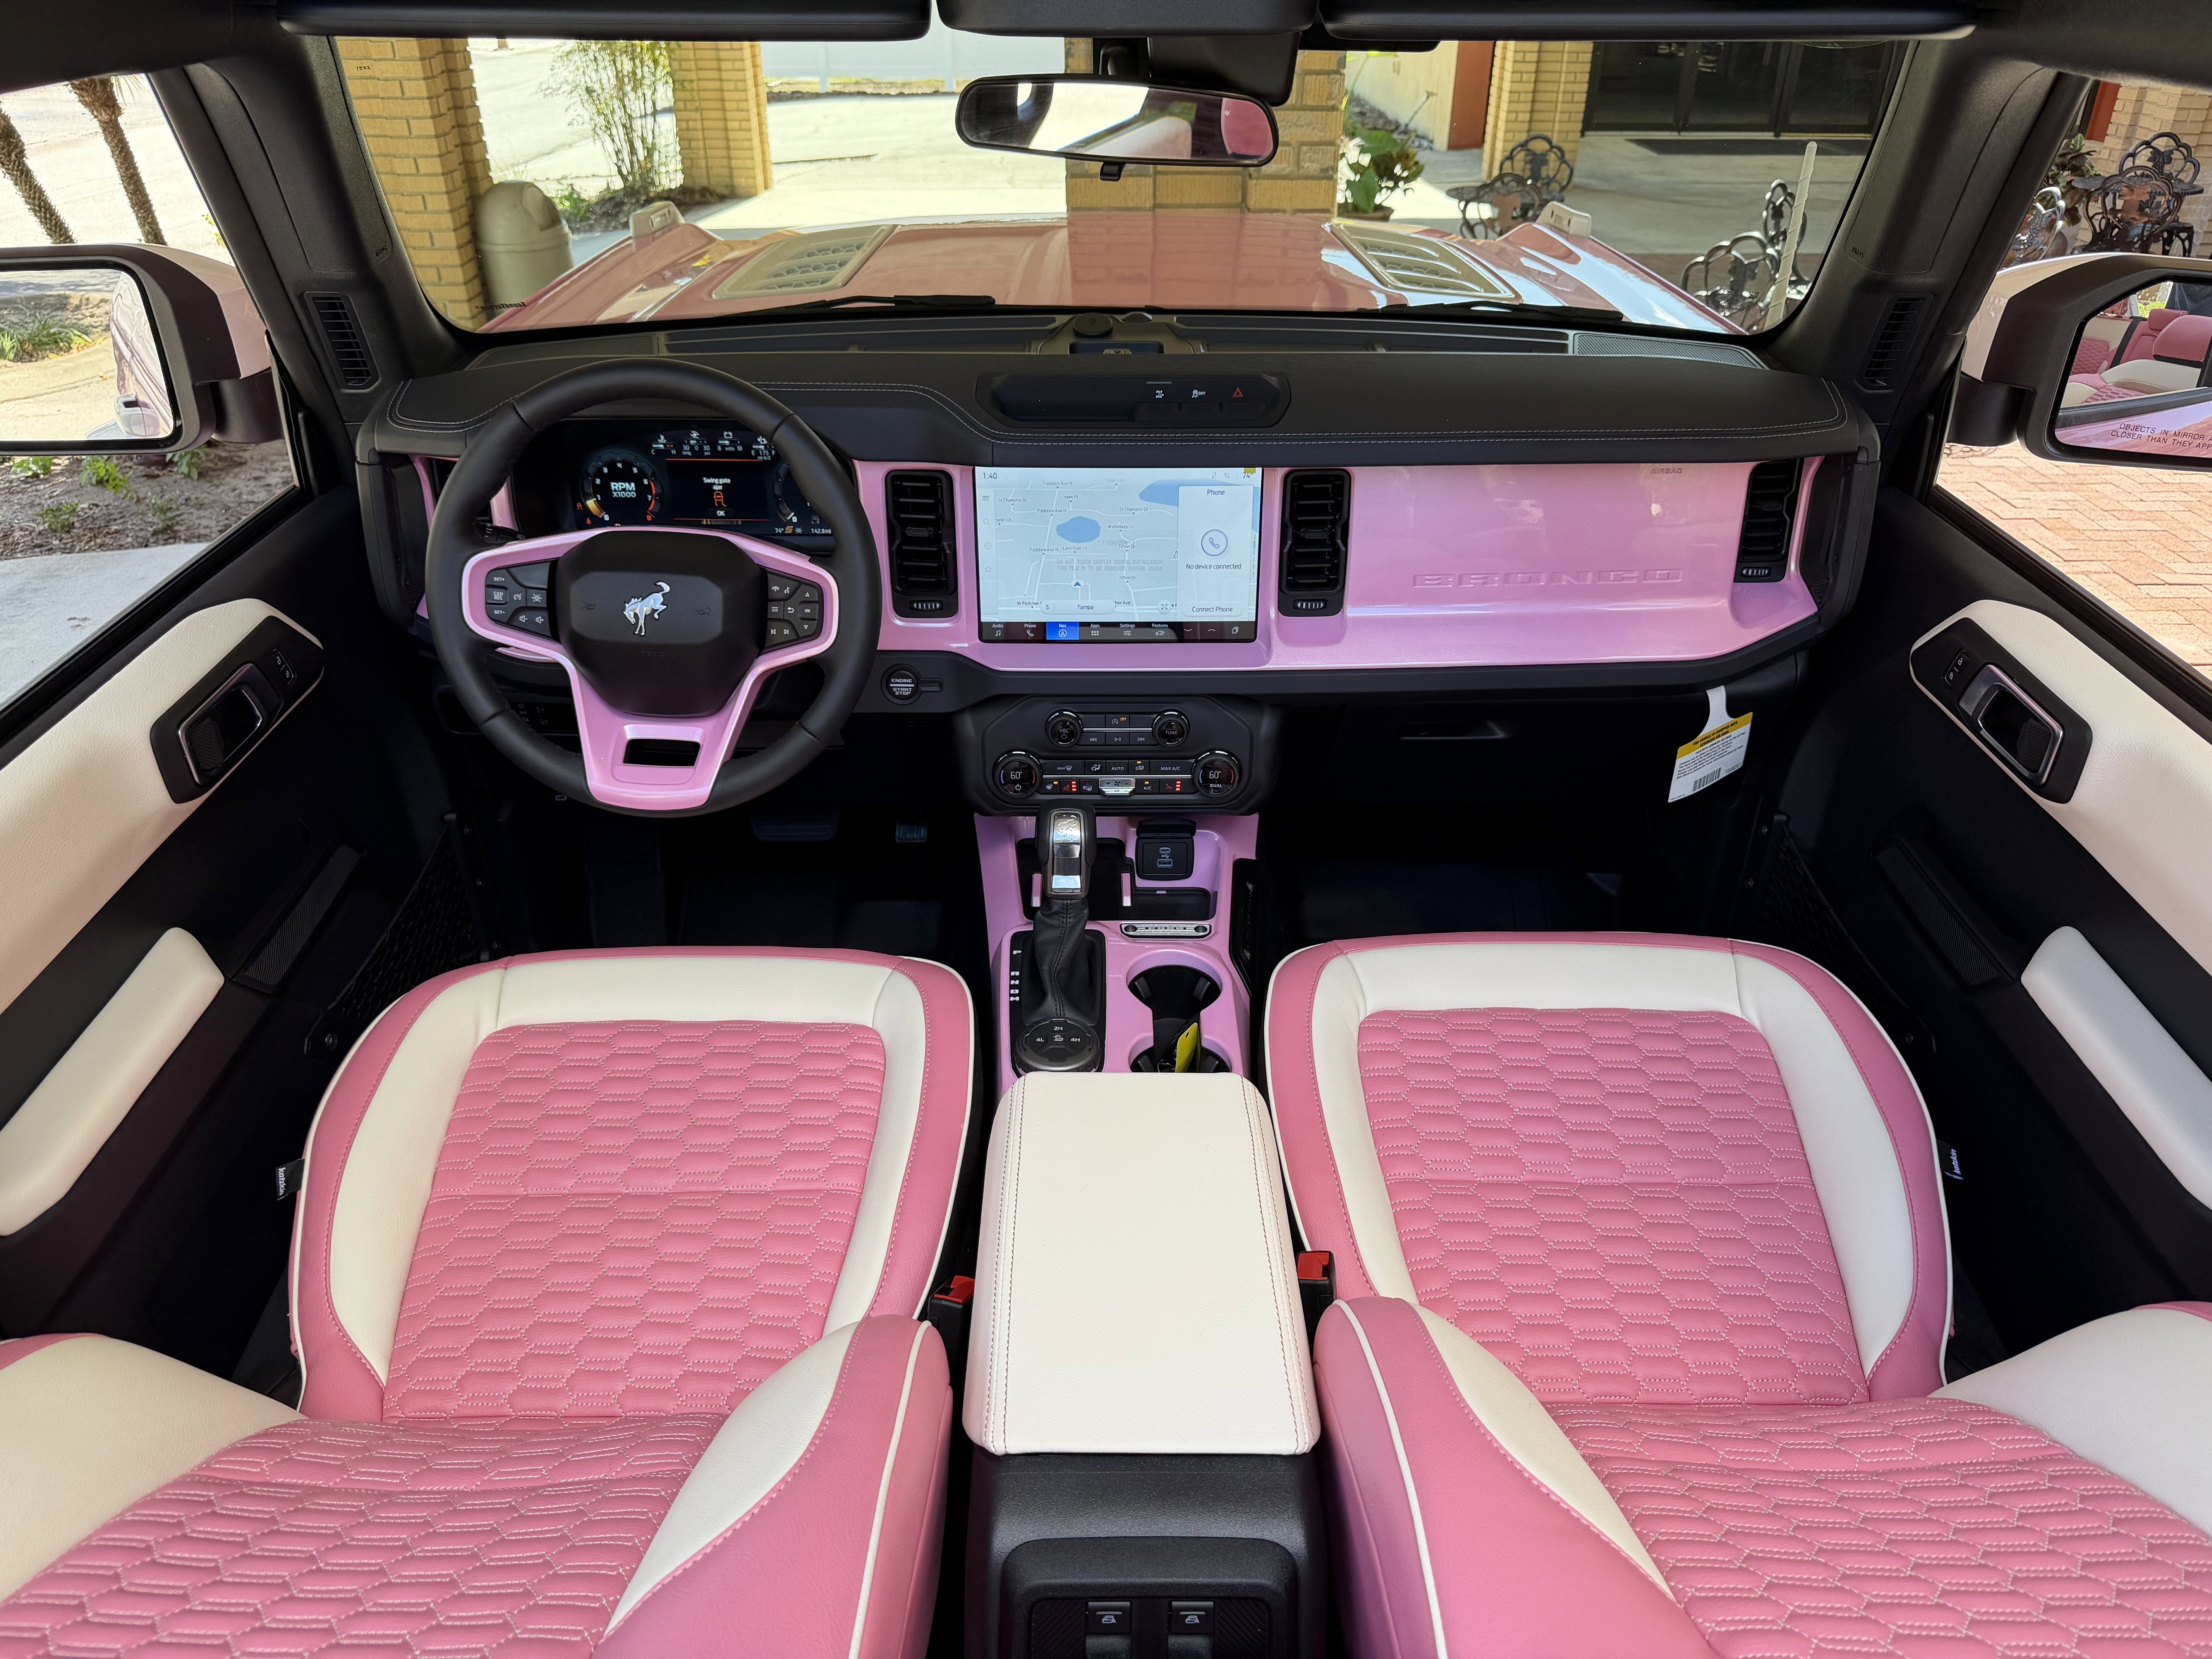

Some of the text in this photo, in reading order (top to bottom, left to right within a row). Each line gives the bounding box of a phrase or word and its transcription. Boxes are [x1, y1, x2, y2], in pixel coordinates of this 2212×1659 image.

[2111, 430, 2142, 440] CLOSER
[2147, 435, 2168, 444] THAN
[2119, 423, 2156, 434] OBJECTS
[2173, 431, 2205, 441] MIRROR
[610, 482, 635, 491] RPM
[1412, 569, 1683, 588] BRONCO
[1950, 1149, 1961, 1175] katzkin
